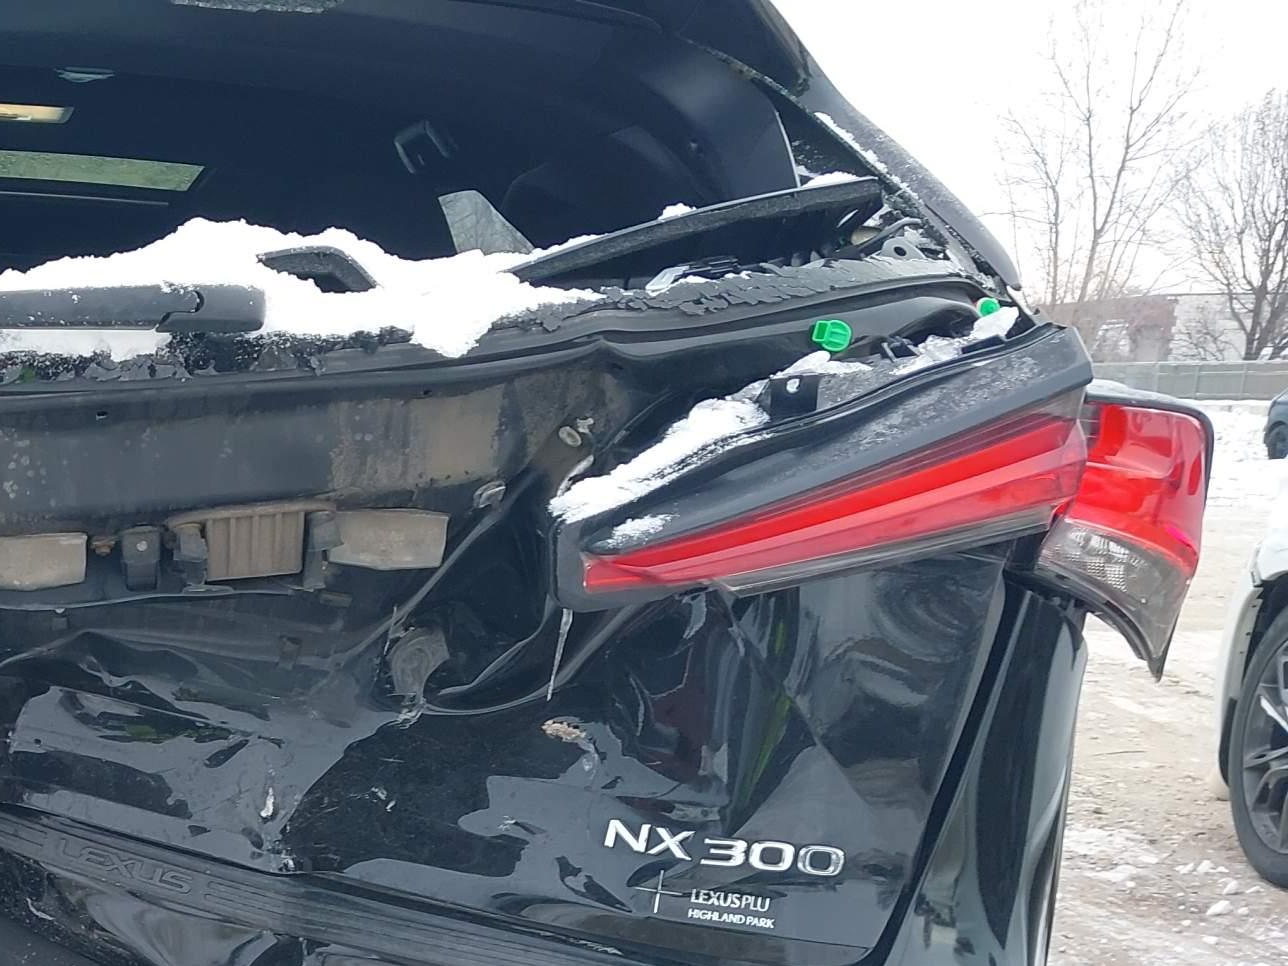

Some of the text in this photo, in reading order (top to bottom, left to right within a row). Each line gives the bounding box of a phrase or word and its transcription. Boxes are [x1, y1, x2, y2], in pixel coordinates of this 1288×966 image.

[59, 837, 194, 895] LEXUS
[603, 819, 846, 876] NX 300
[687, 908, 776, 929] HIGHLAND PARK
